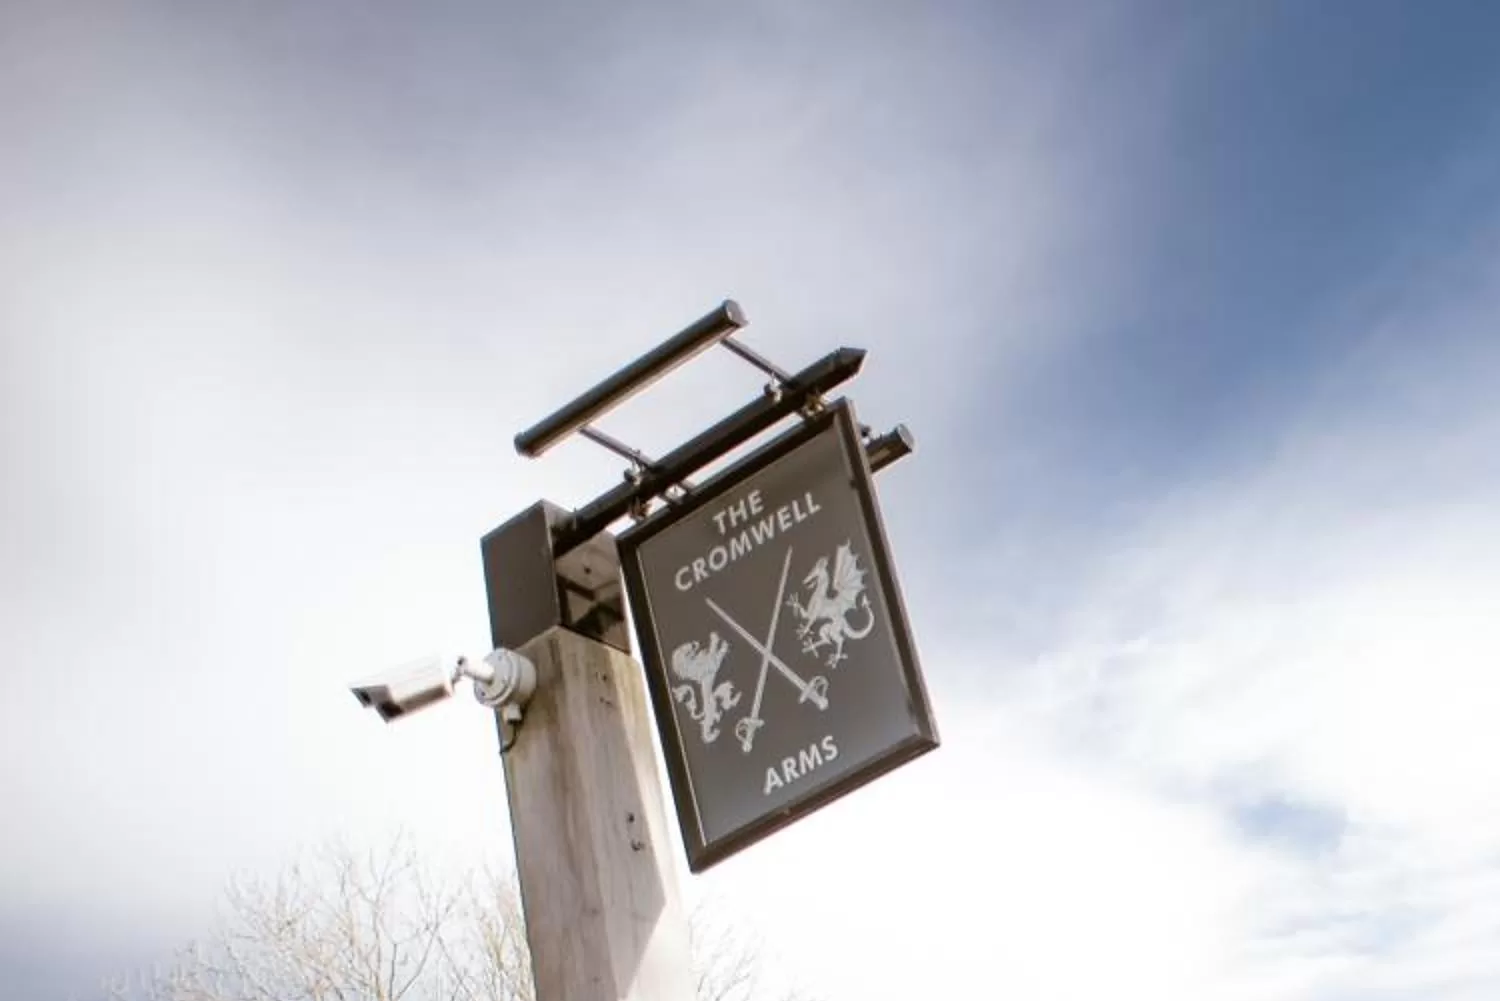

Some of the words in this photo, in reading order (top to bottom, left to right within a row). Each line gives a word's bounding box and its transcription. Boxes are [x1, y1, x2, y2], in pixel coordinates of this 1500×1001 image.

[712, 489, 764, 533] THE
[674, 493, 822, 592] CROMWELL
[763, 736, 839, 795] ARMS
